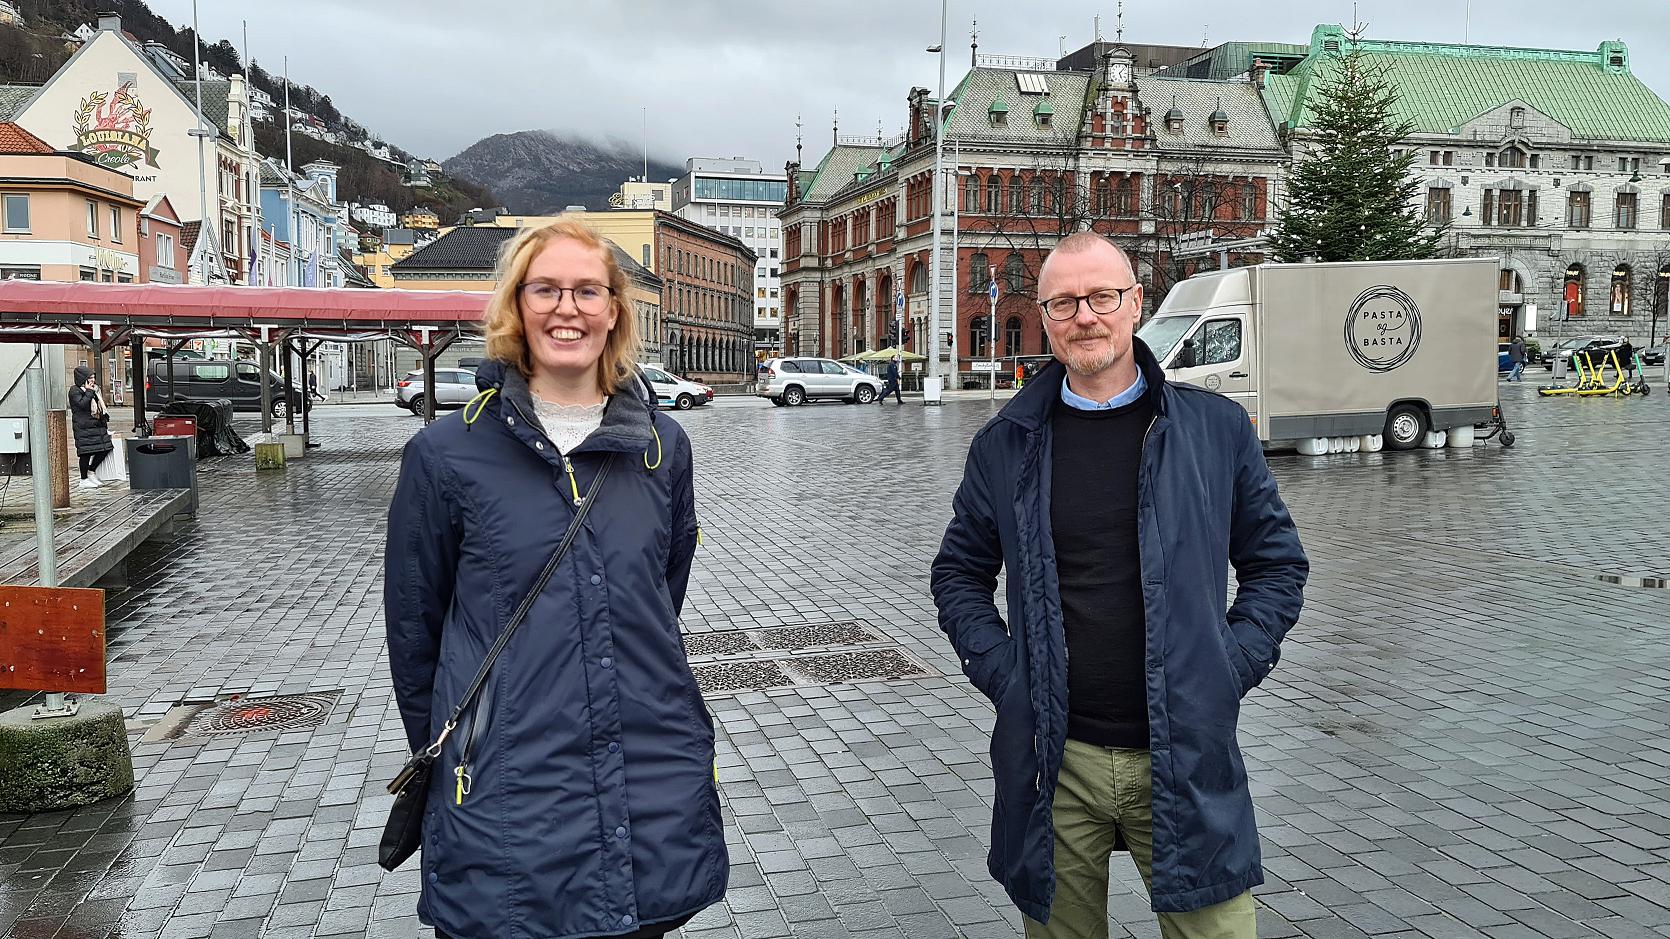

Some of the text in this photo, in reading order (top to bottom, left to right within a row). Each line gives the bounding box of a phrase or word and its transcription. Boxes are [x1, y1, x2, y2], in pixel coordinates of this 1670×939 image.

[80, 130, 147, 150] LOUISIANA
[97, 153, 131, 163] Creole
[1363, 311, 1402, 319] PASTA
[1363, 337, 1402, 346] BASTA
